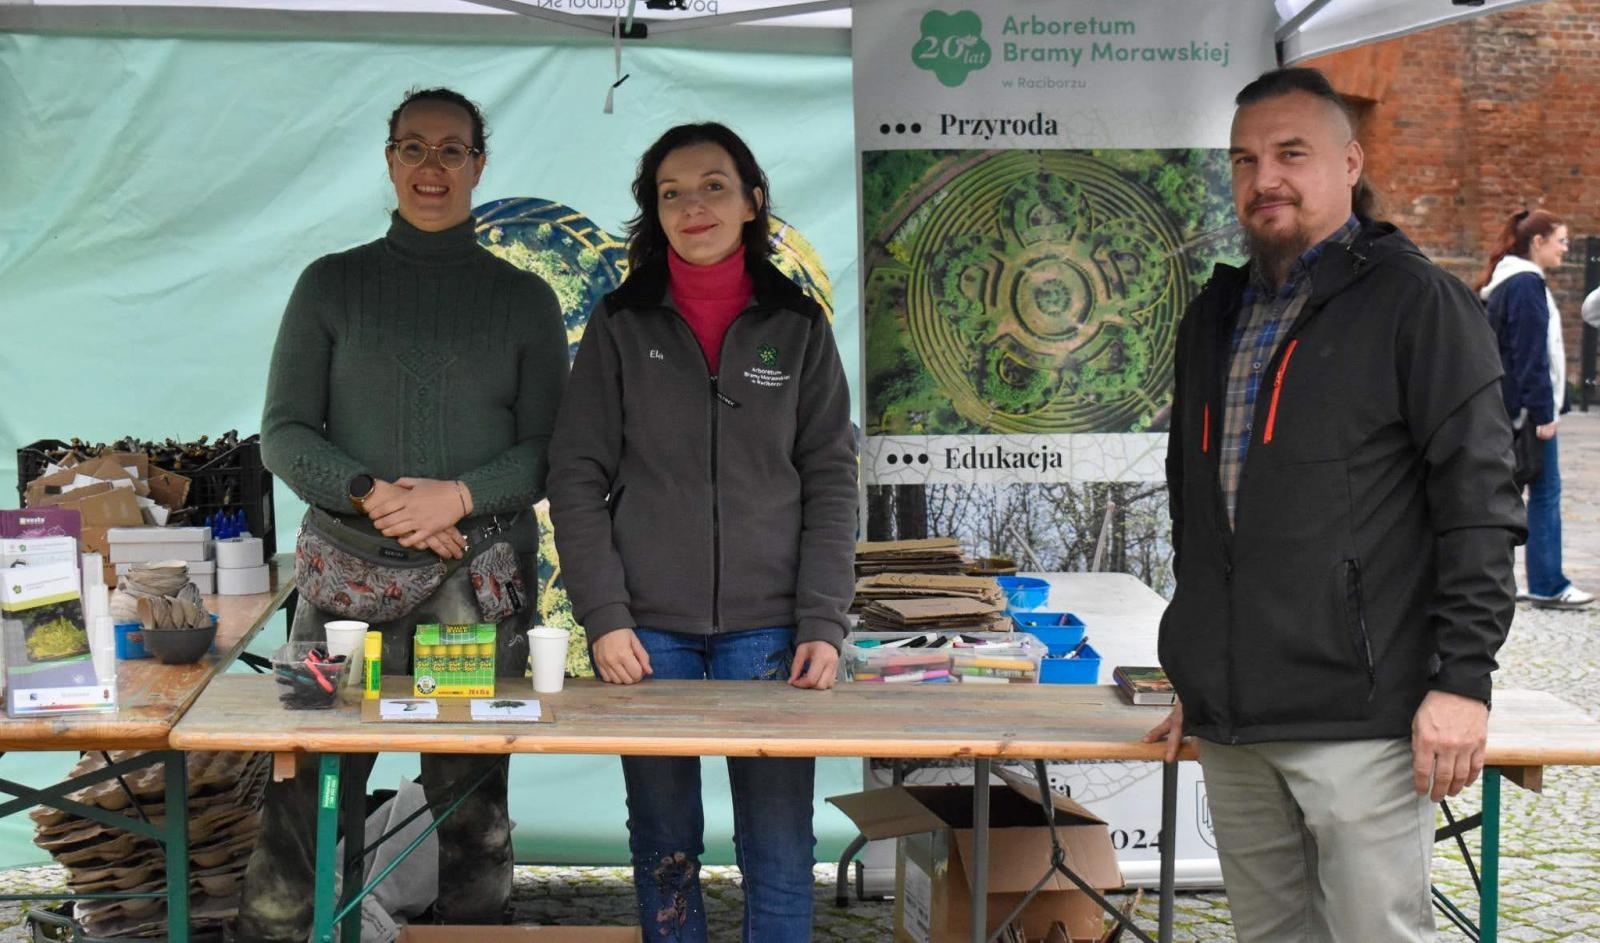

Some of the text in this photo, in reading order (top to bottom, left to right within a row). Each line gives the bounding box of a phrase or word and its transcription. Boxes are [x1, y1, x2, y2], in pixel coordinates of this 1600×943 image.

[1002, 15, 1136, 36] Arboretum
[919, 35, 964, 59] 20
[963, 49, 985, 64] lat
[1003, 40, 1230, 67] Bramy Morawskiej
[1001, 77, 1087, 89] w Raciborzu
[940, 113, 1059, 140] Przyroda
[650, 350, 664, 360] Ela
[944, 445, 1063, 473] Edukacja
